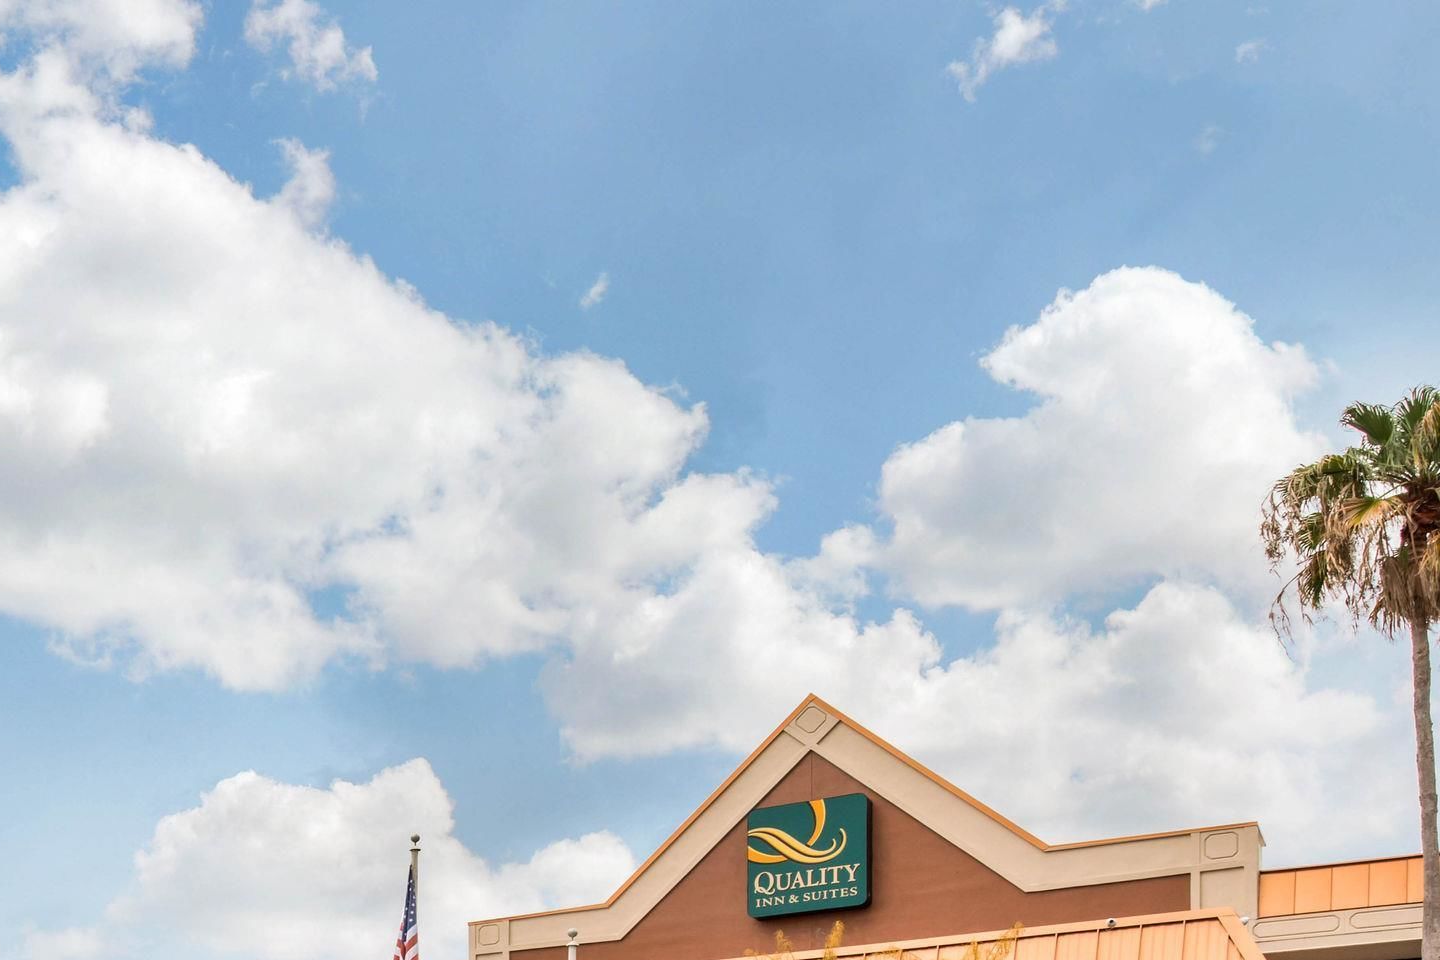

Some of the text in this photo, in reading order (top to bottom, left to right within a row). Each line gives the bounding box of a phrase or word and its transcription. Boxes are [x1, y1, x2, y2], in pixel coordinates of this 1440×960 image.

[753, 863, 861, 895] QUALITY
[756, 886, 858, 908] INN & SUITES
